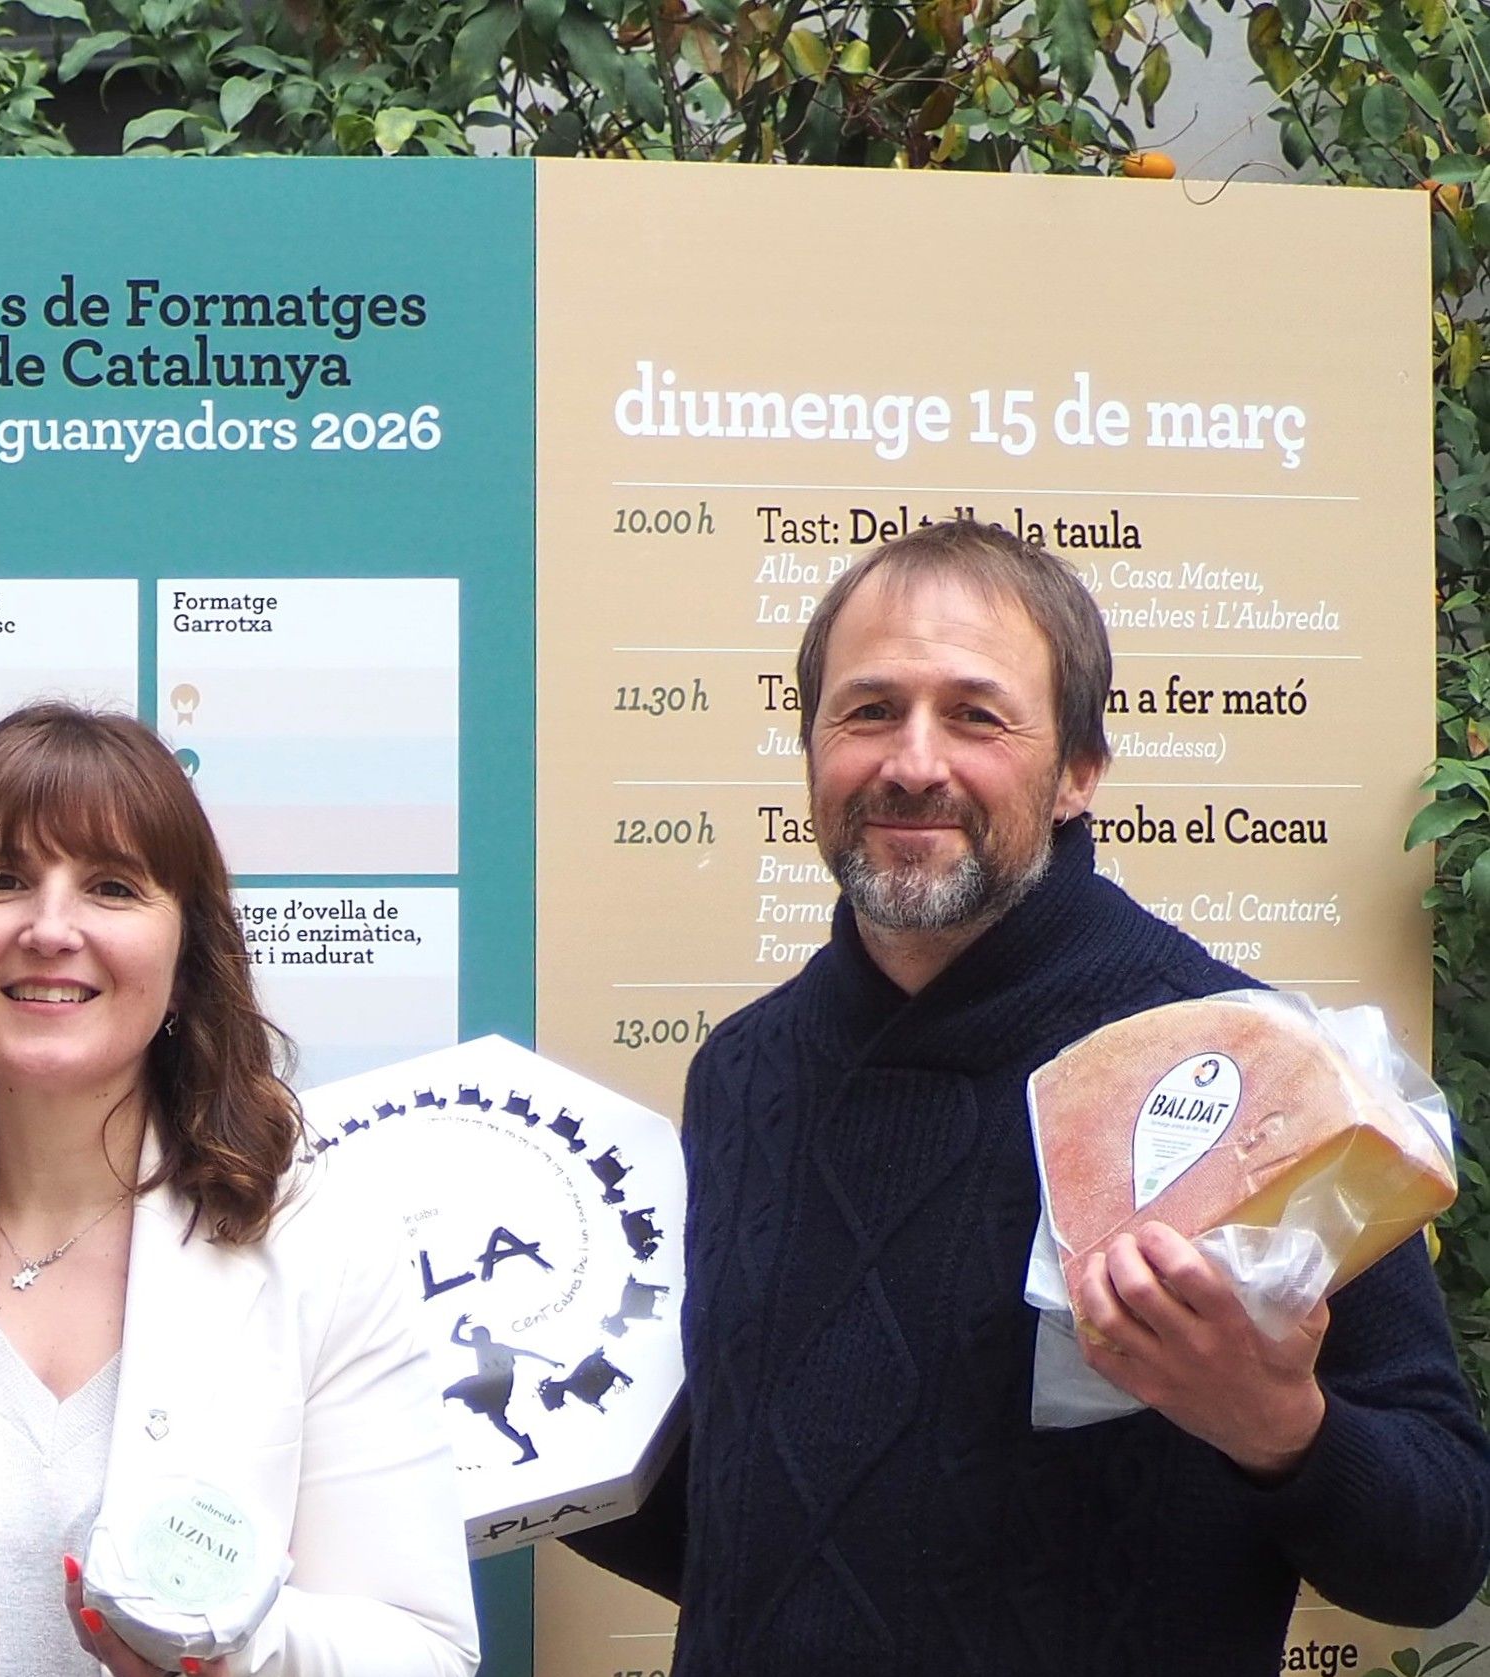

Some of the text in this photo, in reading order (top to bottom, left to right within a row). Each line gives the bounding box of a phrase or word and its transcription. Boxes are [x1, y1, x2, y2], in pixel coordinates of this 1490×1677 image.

[42, 279, 111, 328] de
[125, 279, 428, 339] Formatges
[60, 337, 352, 400] Catalunya
[310, 405, 443, 451] 2026
[614, 360, 1307, 468] diumenge 15 de març
[613, 508, 692, 535] 10.00
[757, 506, 839, 545] Tast:
[1053, 510, 1143, 549] taula
[755, 553, 819, 584] Alba
[1110, 561, 1173, 590] Casa
[1177, 563, 1265, 595] Mateu,
[173, 592, 278, 614] Formatge
[756, 595, 790, 624] La
[1202, 603, 1210, 629] i
[173, 614, 273, 633] Garrotxa
[613, 685, 684, 716] 11.30
[1138, 689, 1158, 714] a
[1165, 674, 1215, 714] fer
[1222, 678, 1308, 715] mató
[613, 819, 692, 844] 12.00
[1186, 804, 1216, 843] el
[1224, 807, 1329, 843] Cacau
[373, 900, 399, 920] de
[1190, 892, 1233, 922] Cal
[1239, 894, 1343, 927] Cantaré,
[269, 946, 276, 964] i
[281, 944, 375, 964] madurat
[297, 923, 422, 945] enzimàtica,
[613, 1018, 690, 1049] 13.00
[1148, 1094, 1230, 1125] BALDAT
[419, 1226, 555, 1302] LA
[163, 1515, 239, 1564] ALZINAR
